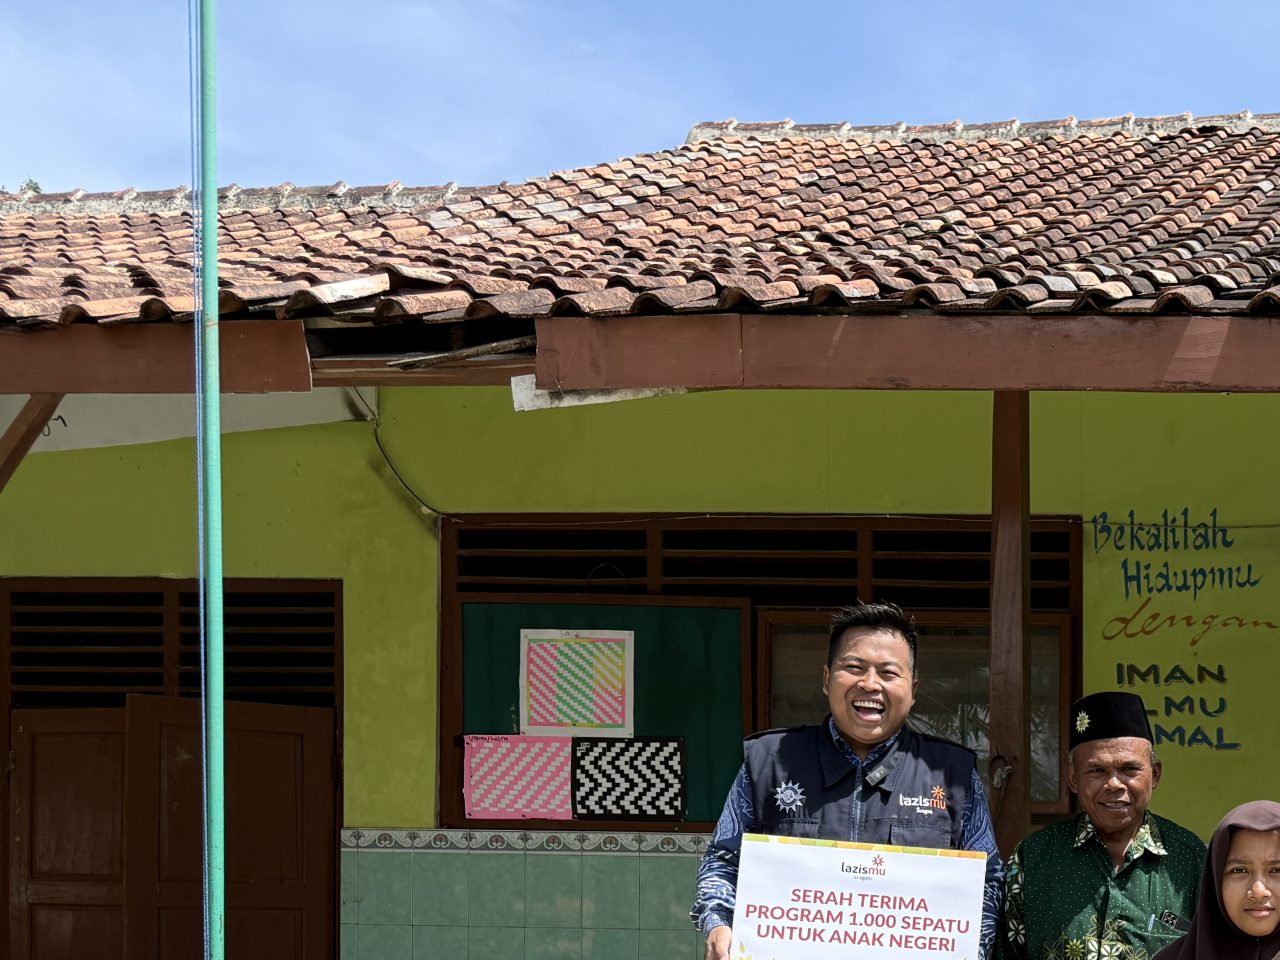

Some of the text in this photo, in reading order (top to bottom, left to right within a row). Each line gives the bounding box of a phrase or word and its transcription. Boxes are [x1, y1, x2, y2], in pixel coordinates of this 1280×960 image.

[1091, 507, 1234, 554] Bekalilah
[1121, 558, 1264, 601] Hidupmu
[1102, 597, 1280, 647] dengan
[1116, 662, 1228, 687] IMAN
[1145, 695, 1227, 717] MU
[1154, 724, 1241, 750] MAL
[899, 793, 947, 810] lazismu
[841, 861, 886, 876] lazismu
[790, 888, 929, 912] SERAH TERIMA
[745, 903, 970, 934] PROGRAM 1.000 SEPATU
[756, 923, 956, 952] UNTUK ANAK NEGERI
